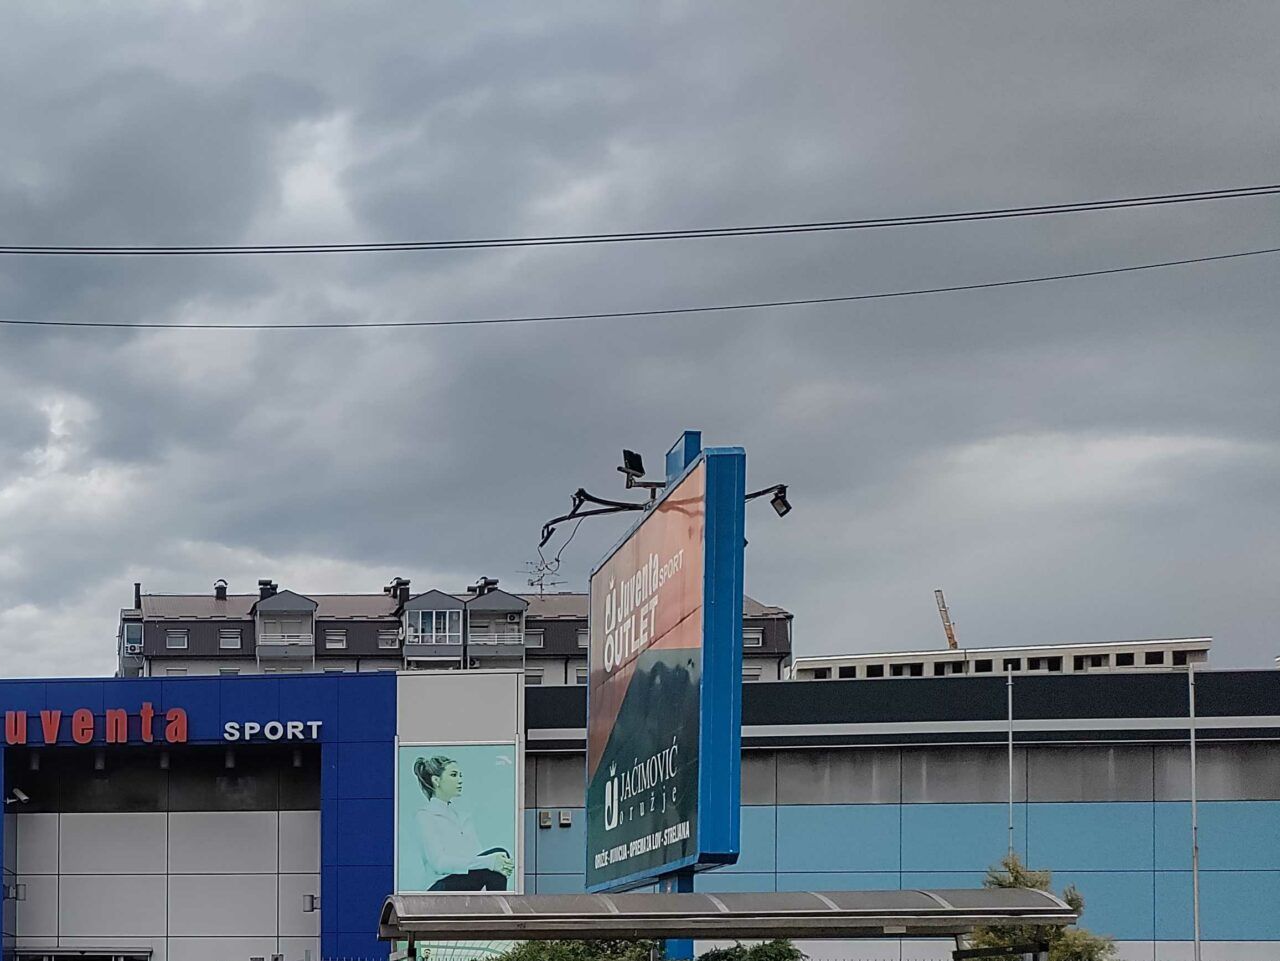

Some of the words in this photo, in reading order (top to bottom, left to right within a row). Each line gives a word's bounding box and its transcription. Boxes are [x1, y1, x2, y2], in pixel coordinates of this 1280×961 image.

[618, 553, 659, 622] Juventa
[659, 549, 684, 587] SPORT
[604, 595, 659, 673] OUTLET
[224, 721, 323, 741] SPORT
[620, 735, 678, 802] JAĆIMOVIĆ
